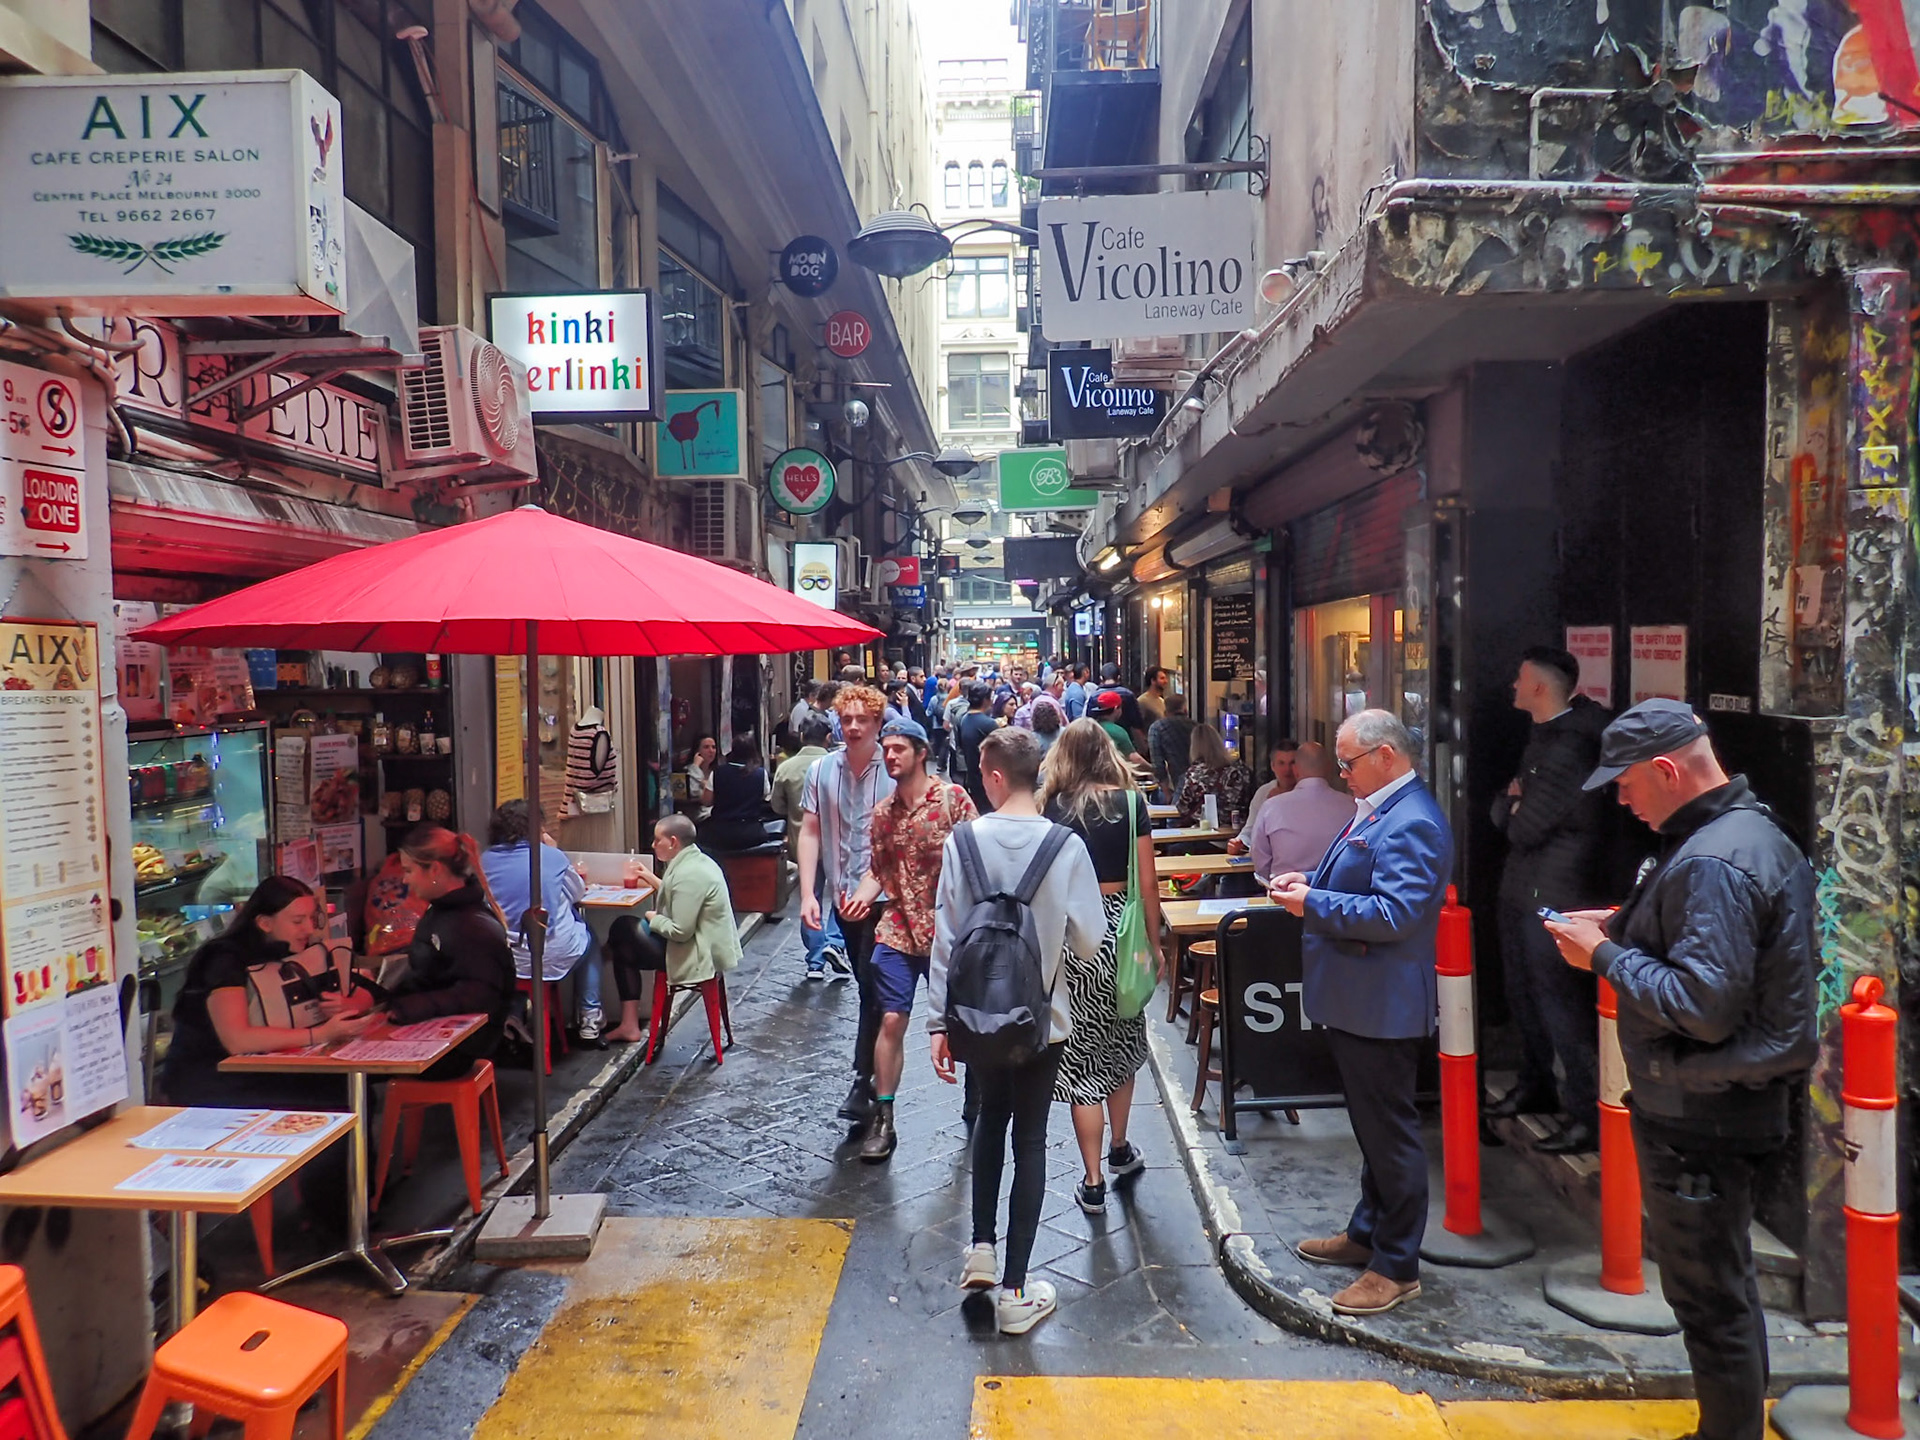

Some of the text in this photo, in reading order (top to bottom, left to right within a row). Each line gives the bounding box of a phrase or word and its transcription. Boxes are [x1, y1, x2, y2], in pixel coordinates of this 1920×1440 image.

[81, 93, 209, 140] AIX
[31, 148, 260, 165] CAFE CREPERIE SALON
[225, 189, 261, 200] 3000
[117, 209, 162, 222] 9662
[170, 208, 216, 222] 2667
[1101, 226, 1144, 250] Cafe
[788, 252, 826, 265] MOON
[1047, 221, 1243, 302] Vicolino
[791, 265, 820, 276] DOG
[1145, 299, 1243, 319] Laneway Cafe
[527, 310, 615, 344] kinki
[830, 321, 864, 346] BAR
[527, 357, 642, 391] erlinki
[1088, 372, 1109, 383] Cafe
[3, 379, 14, 402] 9
[1108, 406, 1154, 417] Laneway Cafe
[786, 473, 817, 482] HELL'S
[25, 477, 78, 504] LOADING
[38, 502, 77, 526] ONE
[10, 633, 72, 665] AIX
[59, 695, 86, 704] MENU
[1243, 982, 1328, 1033] ST
